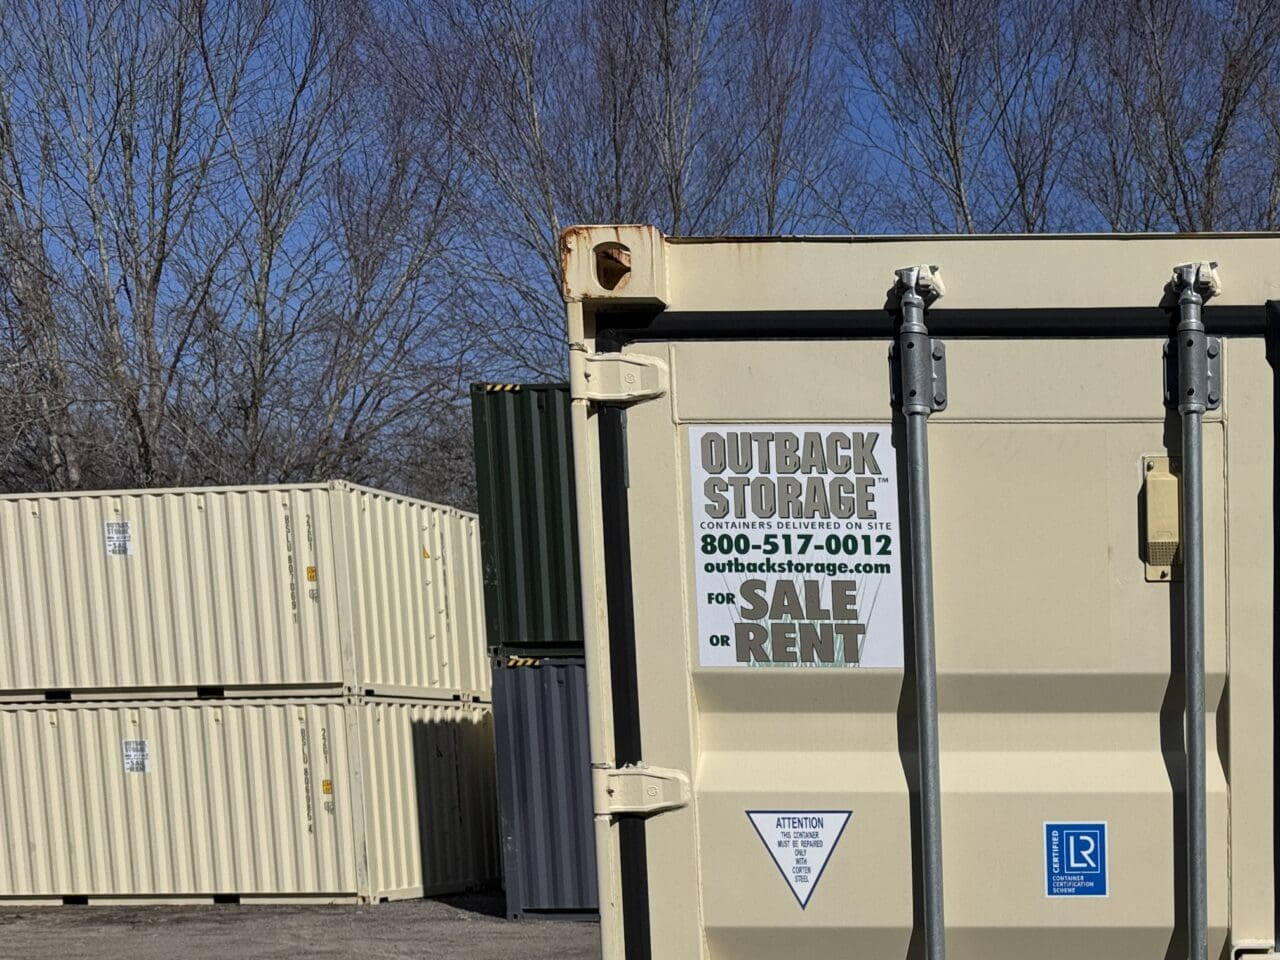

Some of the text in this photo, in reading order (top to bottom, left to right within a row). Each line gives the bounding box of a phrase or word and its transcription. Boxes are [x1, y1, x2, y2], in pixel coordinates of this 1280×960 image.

[700, 431, 882, 474] OUTBACK
[703, 476, 877, 519] STORAGE
[700, 521, 892, 530] CONTAINERS DELIVERED ON SITE
[701, 533, 892, 556] 800-517-0012
[704, 558, 891, 576] outbackstorage.com
[707, 579, 858, 621] FOR SALE
[709, 622, 866, 663] OR RENT
[776, 816, 824, 829] ATTENTION
[777, 840, 823, 848] MUST BE REPAIRED
[781, 831, 819, 839] THIS CONTAINER
[794, 849, 807, 857] ONLY
[1051, 830, 1097, 874] CERTIFIED LR
[792, 866, 811, 874] CORTEN
